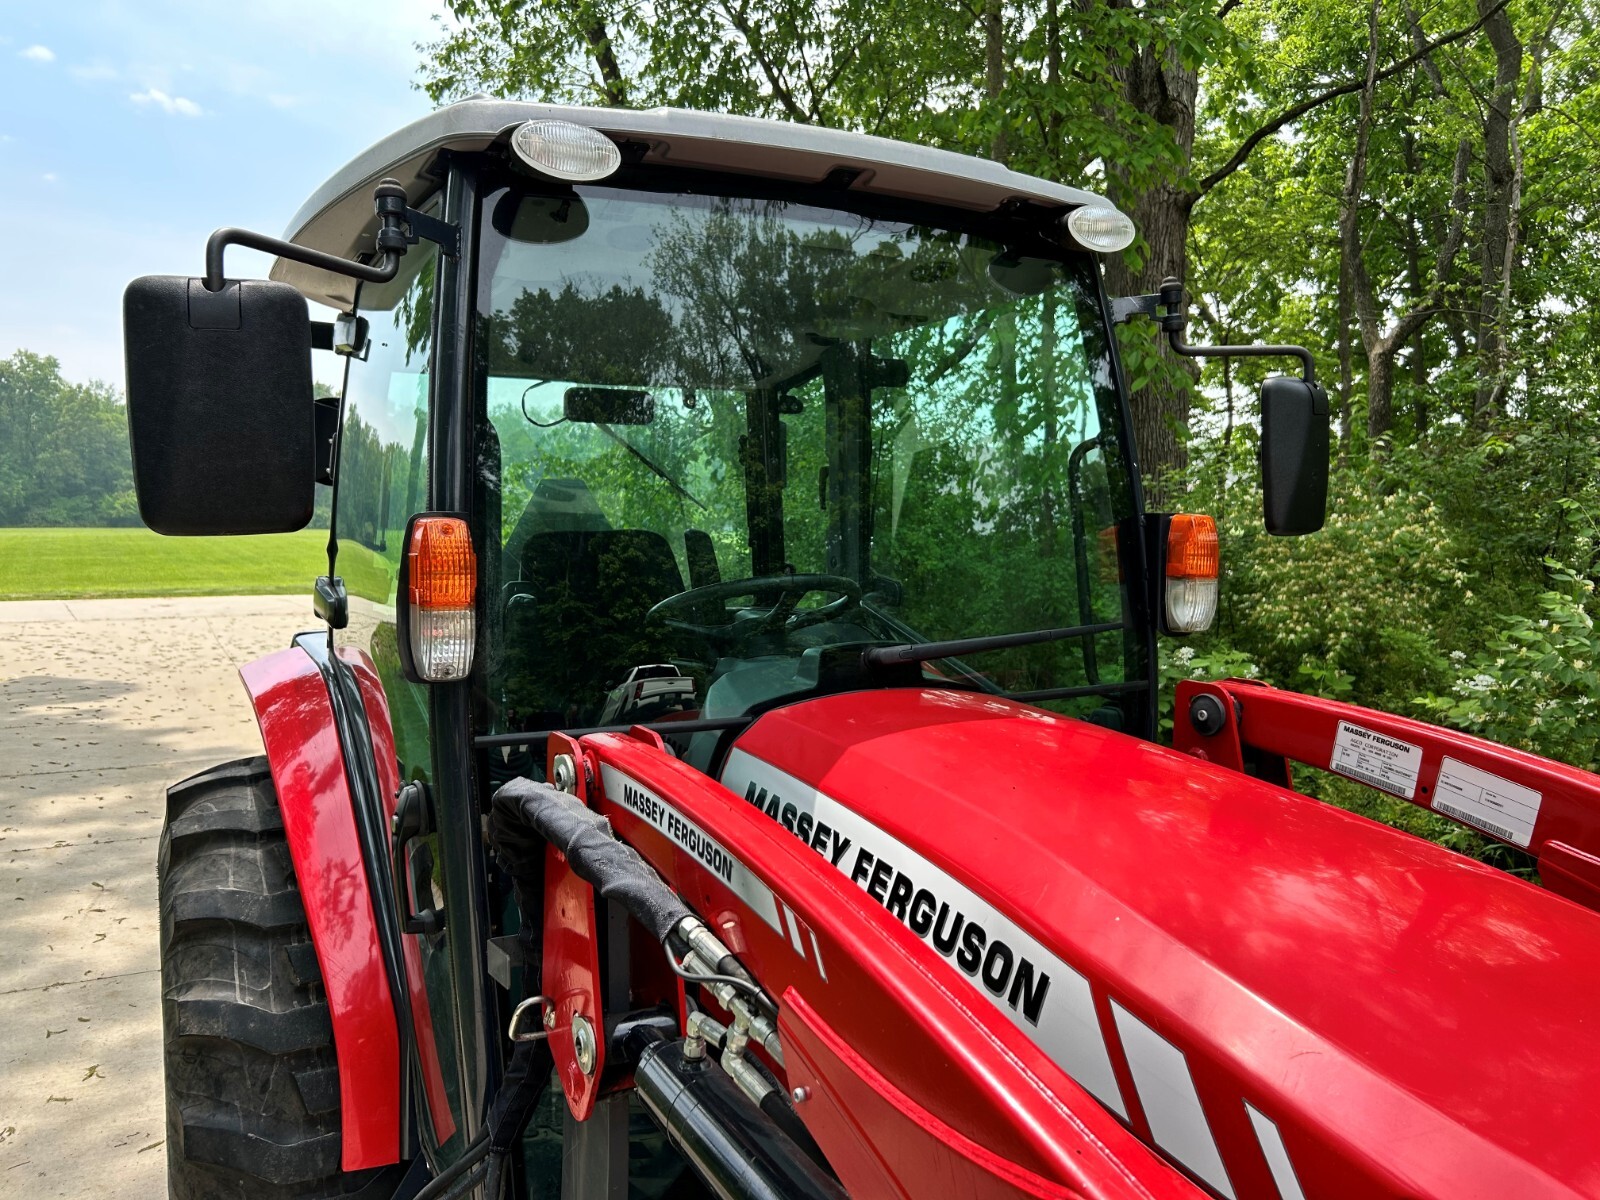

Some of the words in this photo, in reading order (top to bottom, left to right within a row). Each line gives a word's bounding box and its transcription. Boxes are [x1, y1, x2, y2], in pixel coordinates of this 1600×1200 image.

[1344, 726, 1371, 740] MASSEY
[1372, 735, 1410, 753] FERGUSON
[1365, 742, 1398, 758] CORPORATION
[624, 784, 665, 827] MASSEY
[667, 811, 733, 884] FERGUSON
[745, 781, 851, 867] MASSEY
[851, 846, 1051, 1027] FERGUSON
